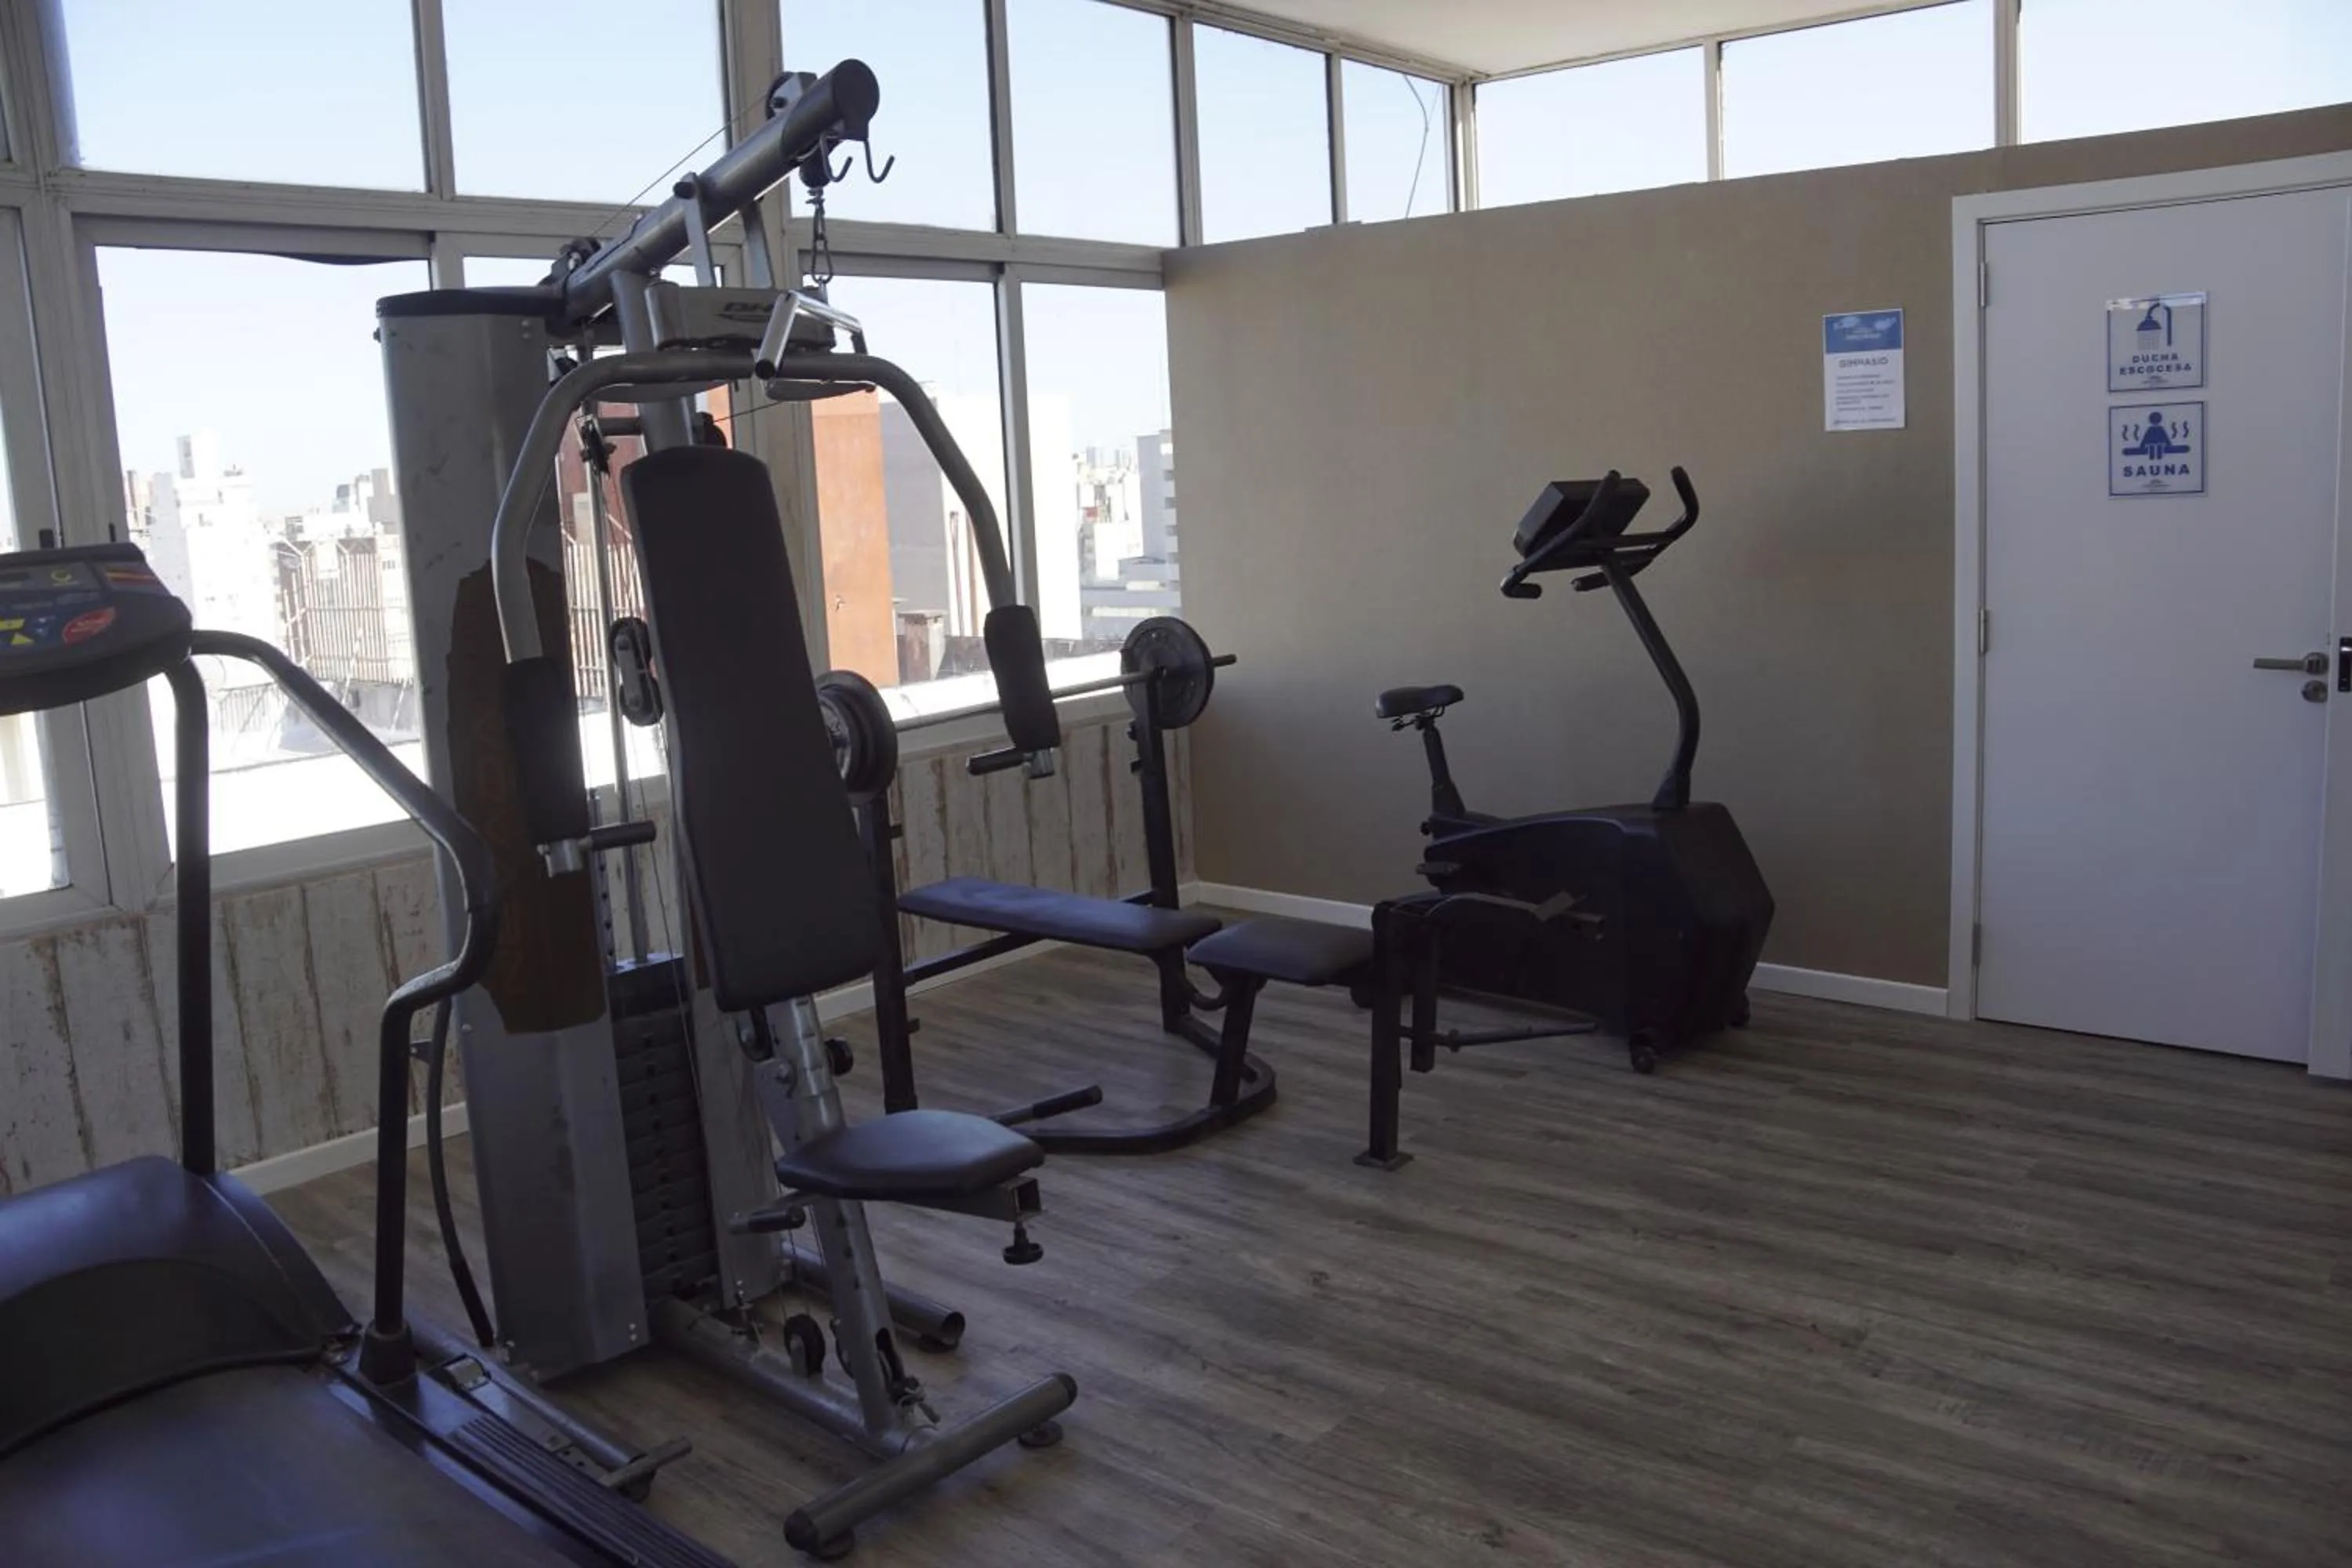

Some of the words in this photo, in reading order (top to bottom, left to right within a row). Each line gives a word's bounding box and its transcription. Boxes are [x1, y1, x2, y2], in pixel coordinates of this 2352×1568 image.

[2132, 354, 2179, 363] DUCHA
[2119, 363, 2192, 375] ESCOCESA
[2122, 463, 2190, 477] SAUNA
